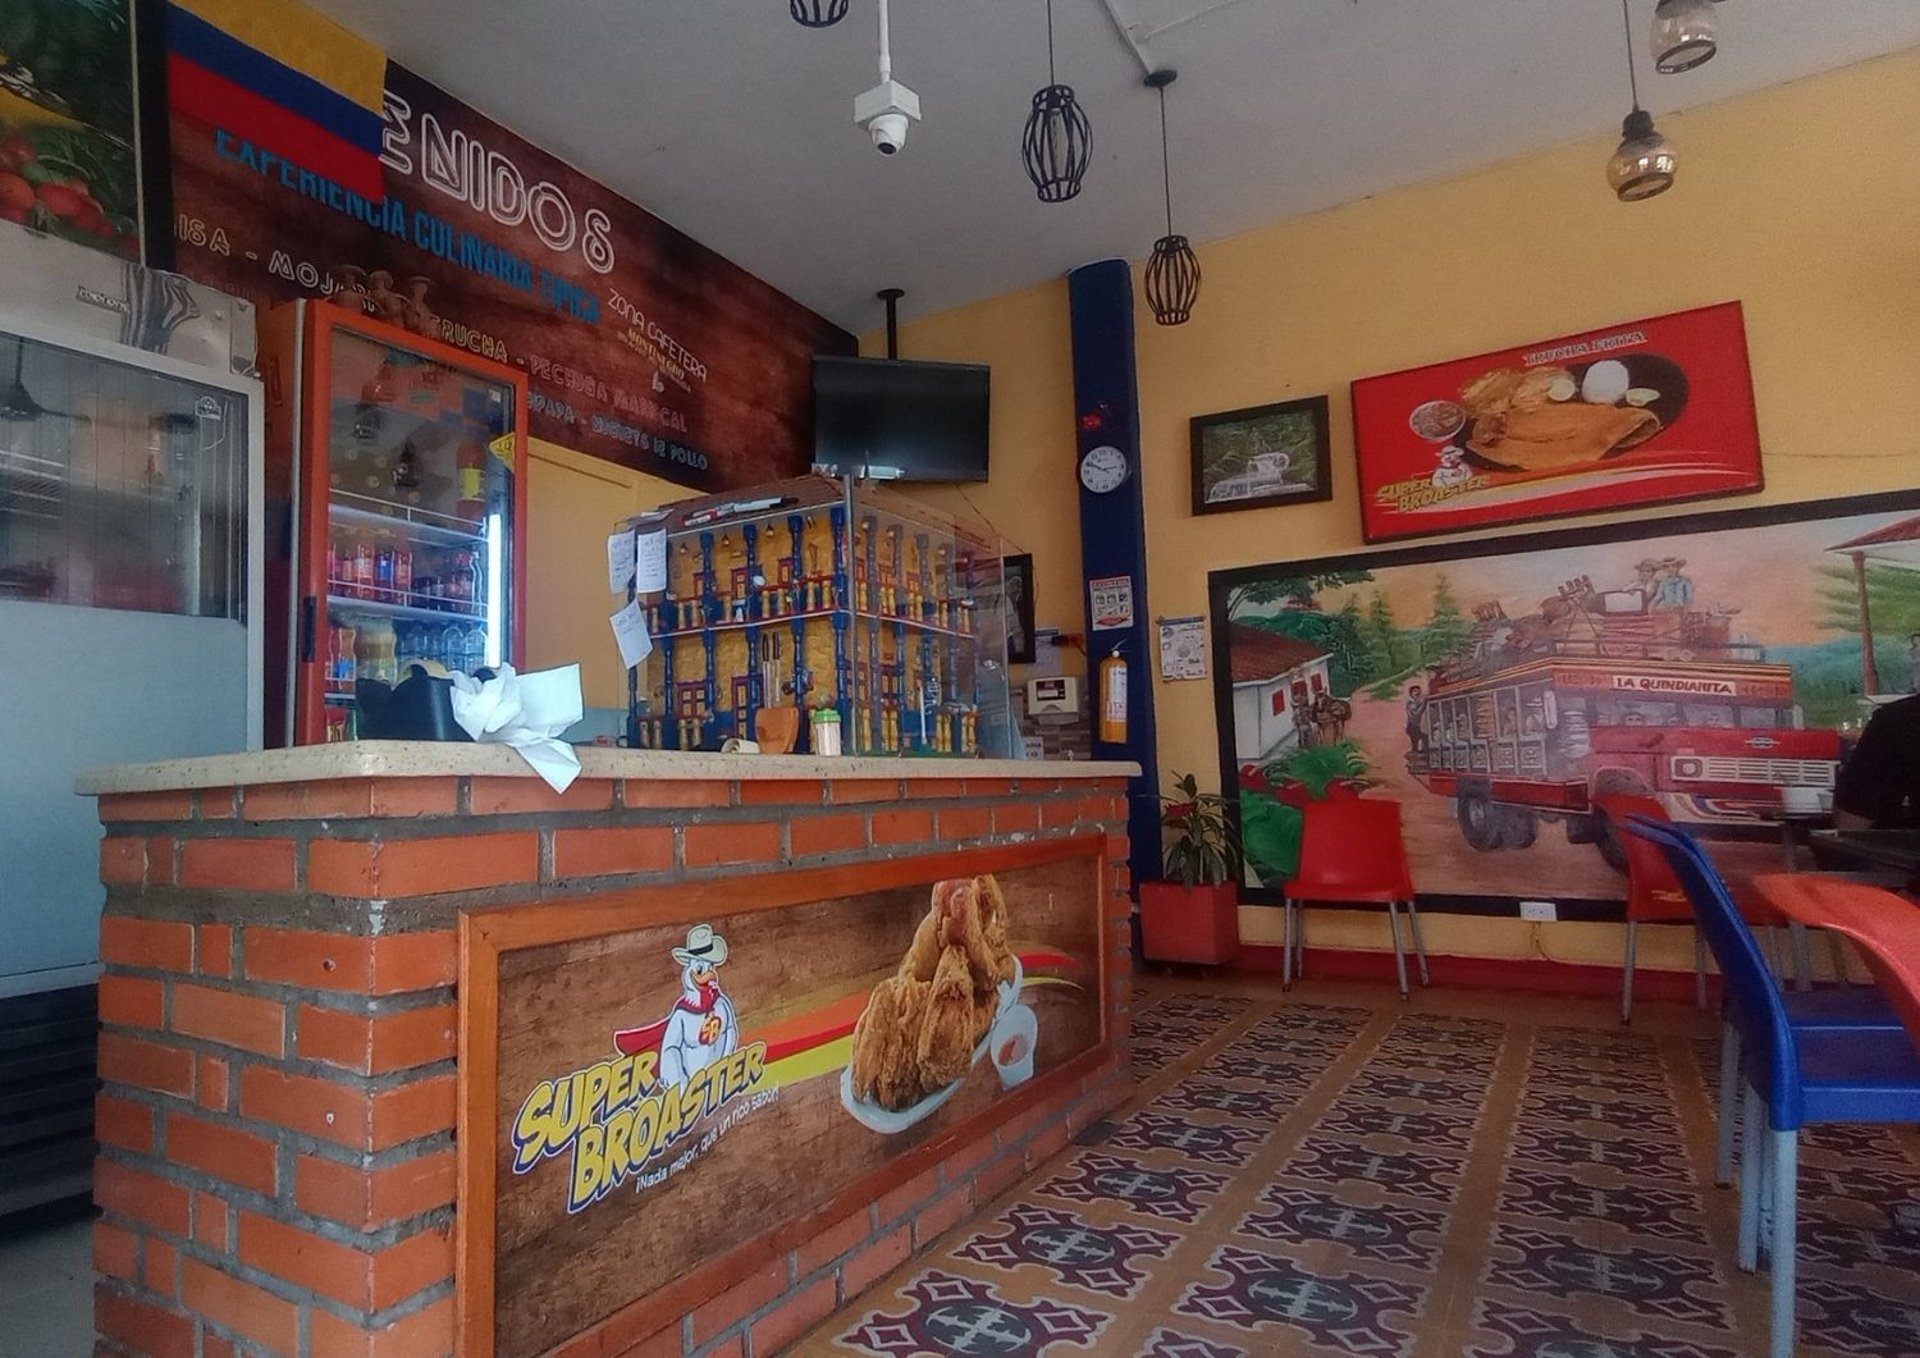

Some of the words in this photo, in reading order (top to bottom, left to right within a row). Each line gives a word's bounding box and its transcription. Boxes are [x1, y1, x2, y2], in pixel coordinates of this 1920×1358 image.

[174, 214, 230, 256] ISA
[414, 210, 533, 292] CULINARIA
[608, 287, 644, 331] ZONA
[648, 321, 707, 383] CAFETERA
[1616, 678, 1635, 688] LA
[513, 1050, 660, 1173] SUPER
[568, 1042, 767, 1214] BROASTER
[701, 1127, 717, 1151] que
[719, 1116, 731, 1135] un
[732, 1102, 750, 1125] rico
